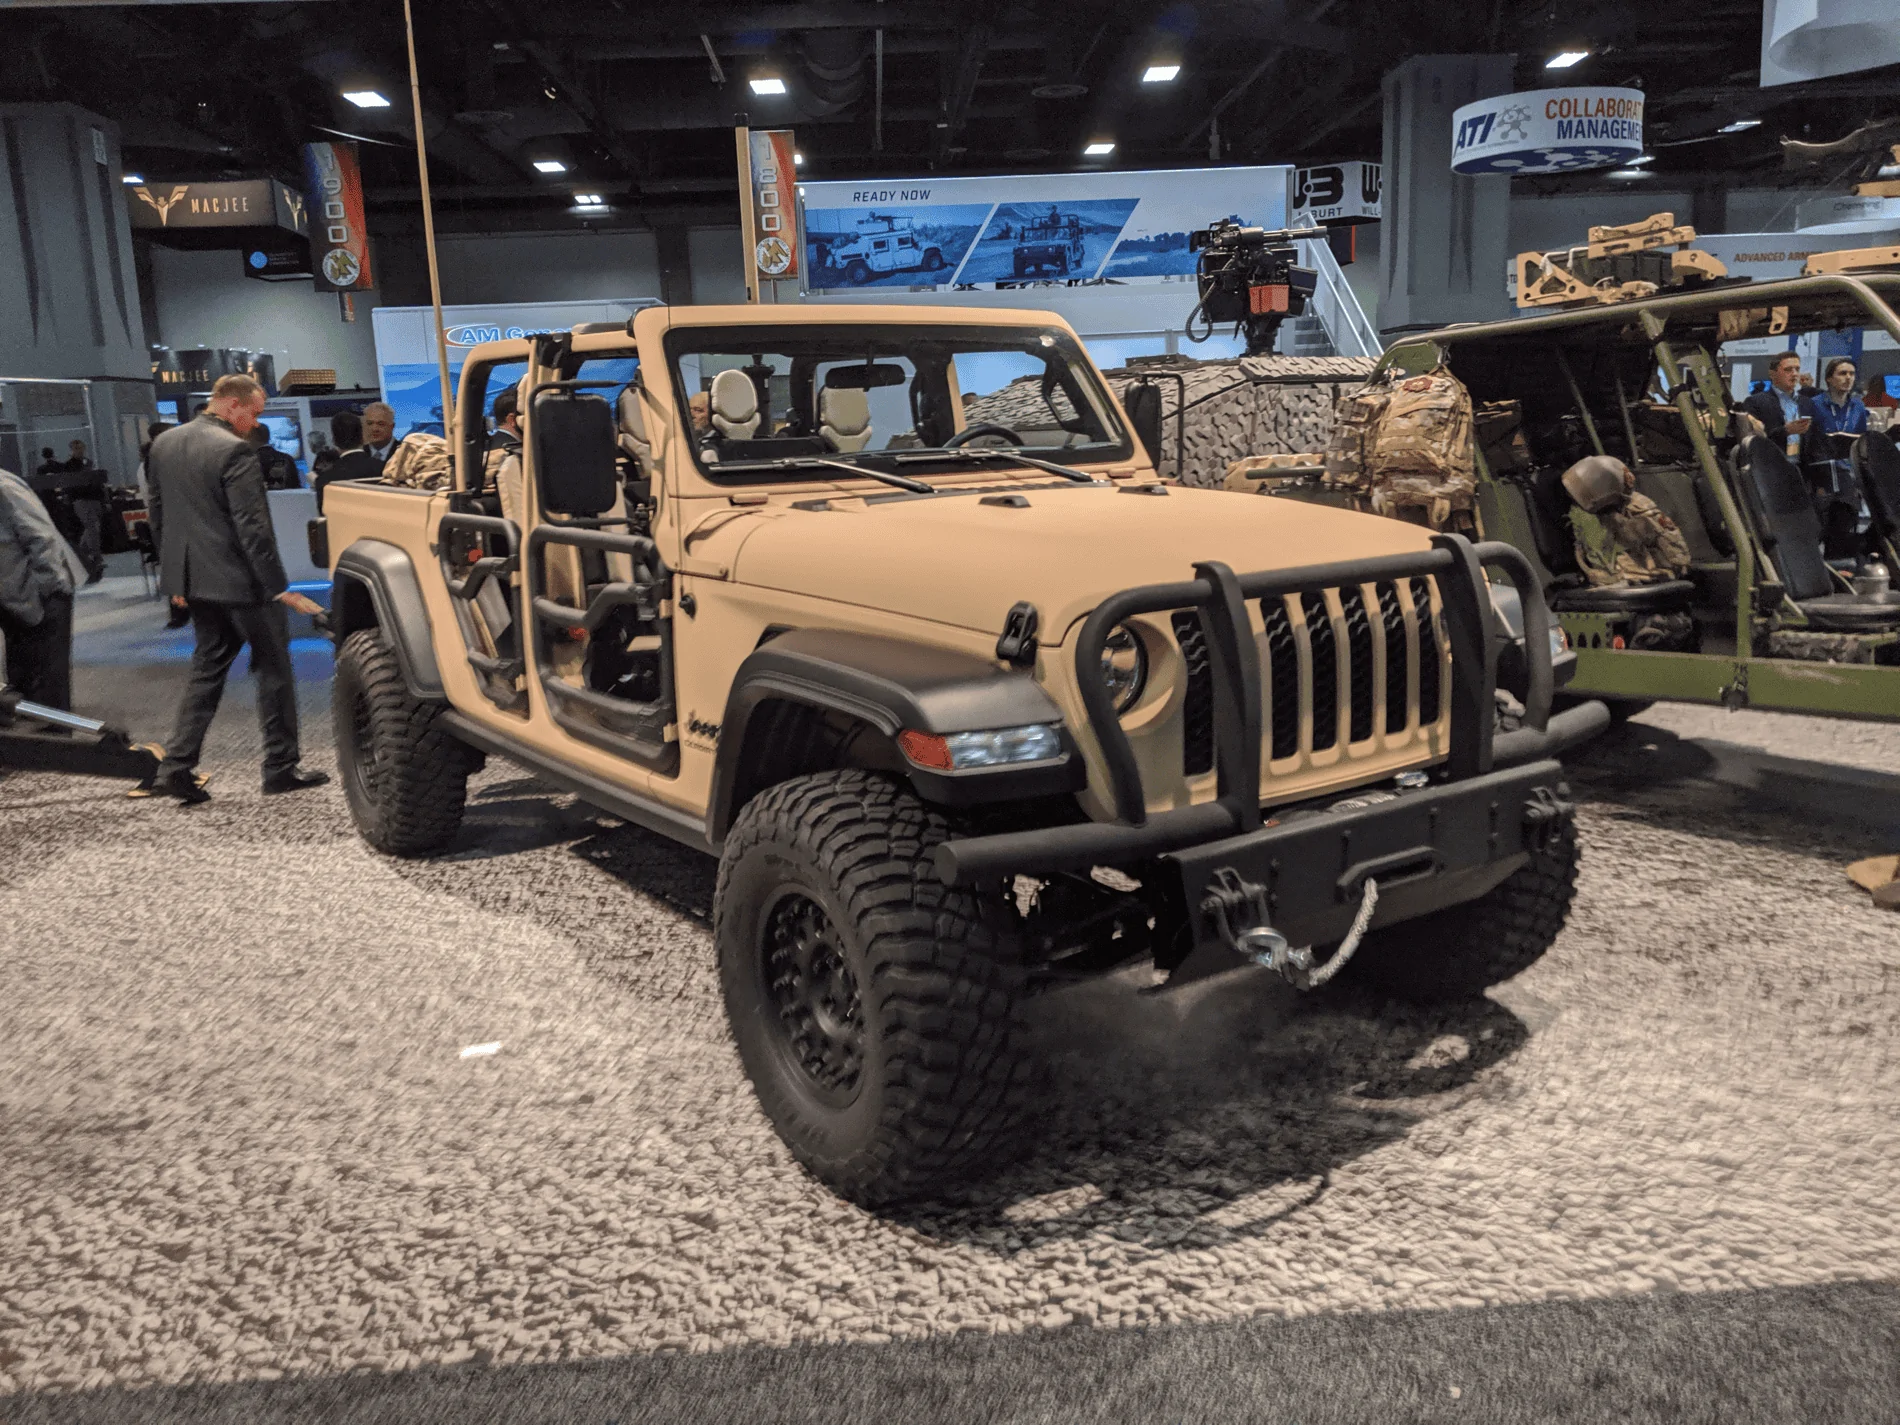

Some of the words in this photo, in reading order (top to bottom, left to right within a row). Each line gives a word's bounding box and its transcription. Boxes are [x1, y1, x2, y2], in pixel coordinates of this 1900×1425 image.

[1454, 112, 1497, 155] ATI
[759, 142, 781, 232] 1800
[853, 191, 896, 202] READY
[900, 189, 931, 200] NOW
[191, 197, 249, 214] MACJEE
[1734, 252, 1785, 262] ADVANCED
[1787, 251, 1822, 261] ARM
[460, 328, 500, 343] AM
